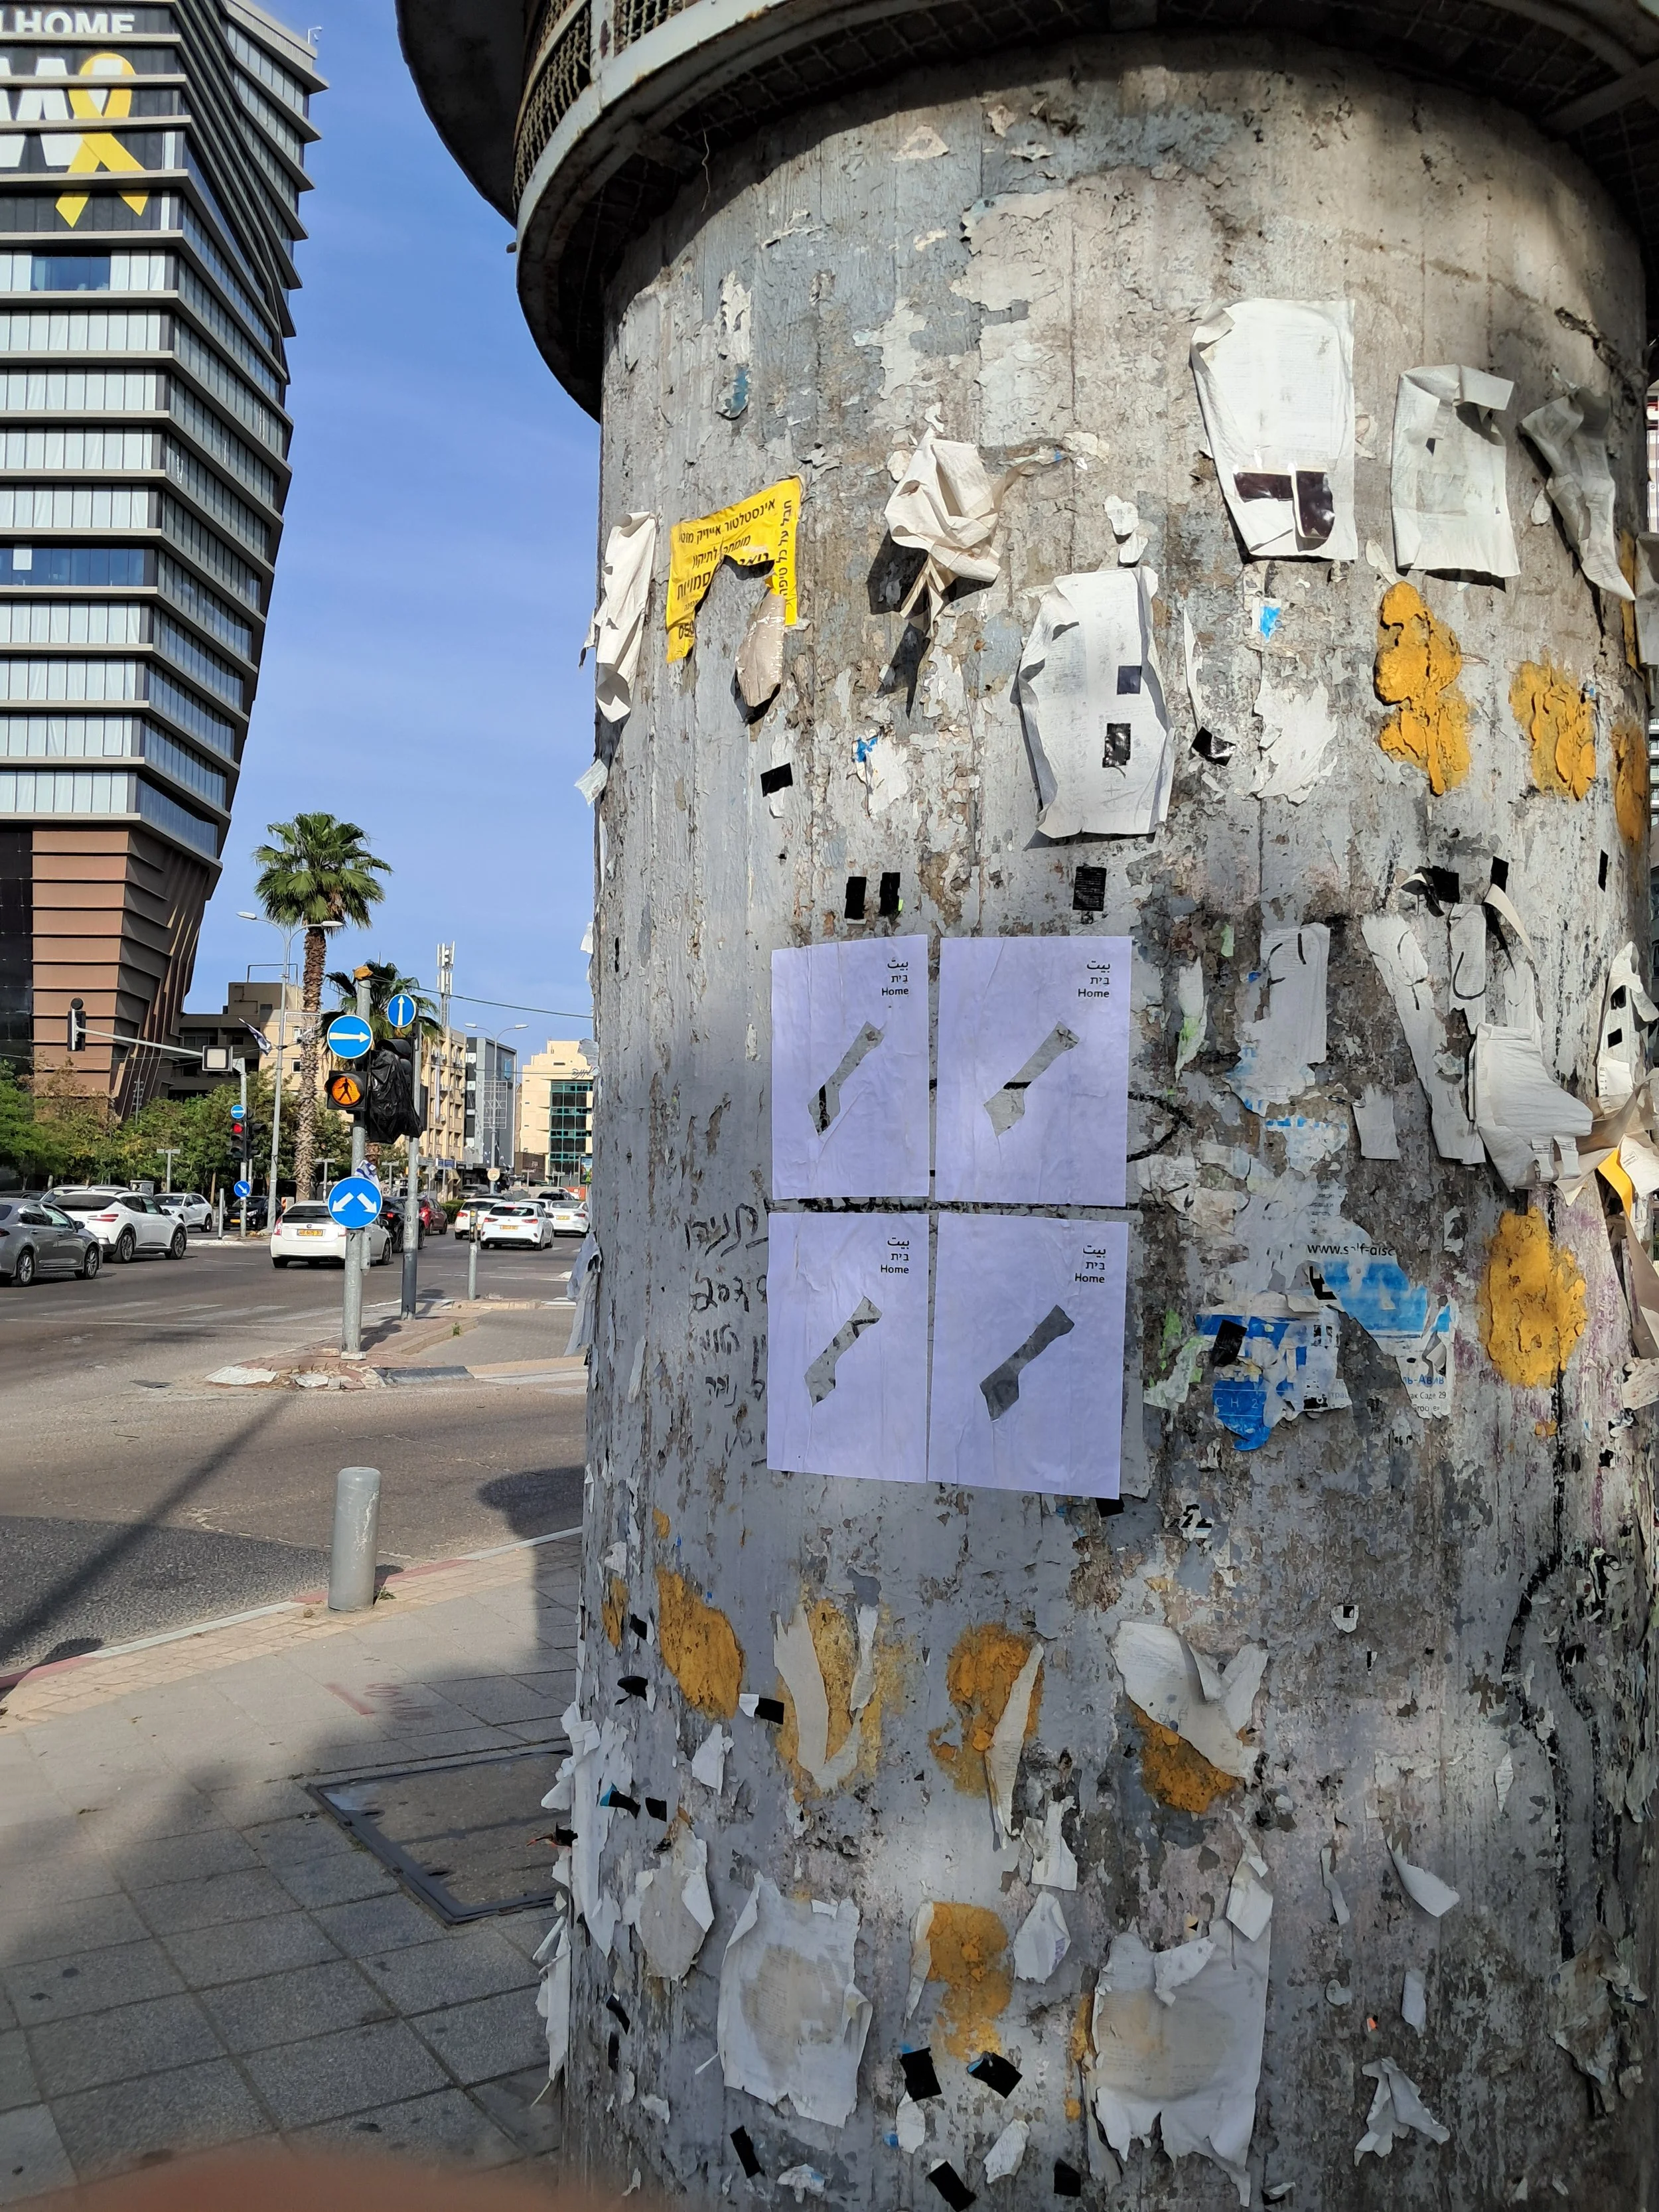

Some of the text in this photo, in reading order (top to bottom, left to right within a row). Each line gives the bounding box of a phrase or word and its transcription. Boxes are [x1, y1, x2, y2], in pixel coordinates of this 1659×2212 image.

[15, 11, 135, 33] HOME
[724, 498, 776, 532] אינסטלטור
[776, 500, 792, 595] חבל על כל טיפה
[677, 571, 711, 601] סמויות
[887, 960, 908, 971] بيت
[1086, 960, 1110, 973] بيت
[881, 987, 909, 996] Home
[1078, 988, 1110, 997] Home
[350, 1232, 356, 1242] 7
[887, 1237, 909, 1250] بيت
[1083, 1245, 1106, 1258] بيت
[881, 1264, 909, 1274] Home
[1074, 1272, 1105, 1284] Home
